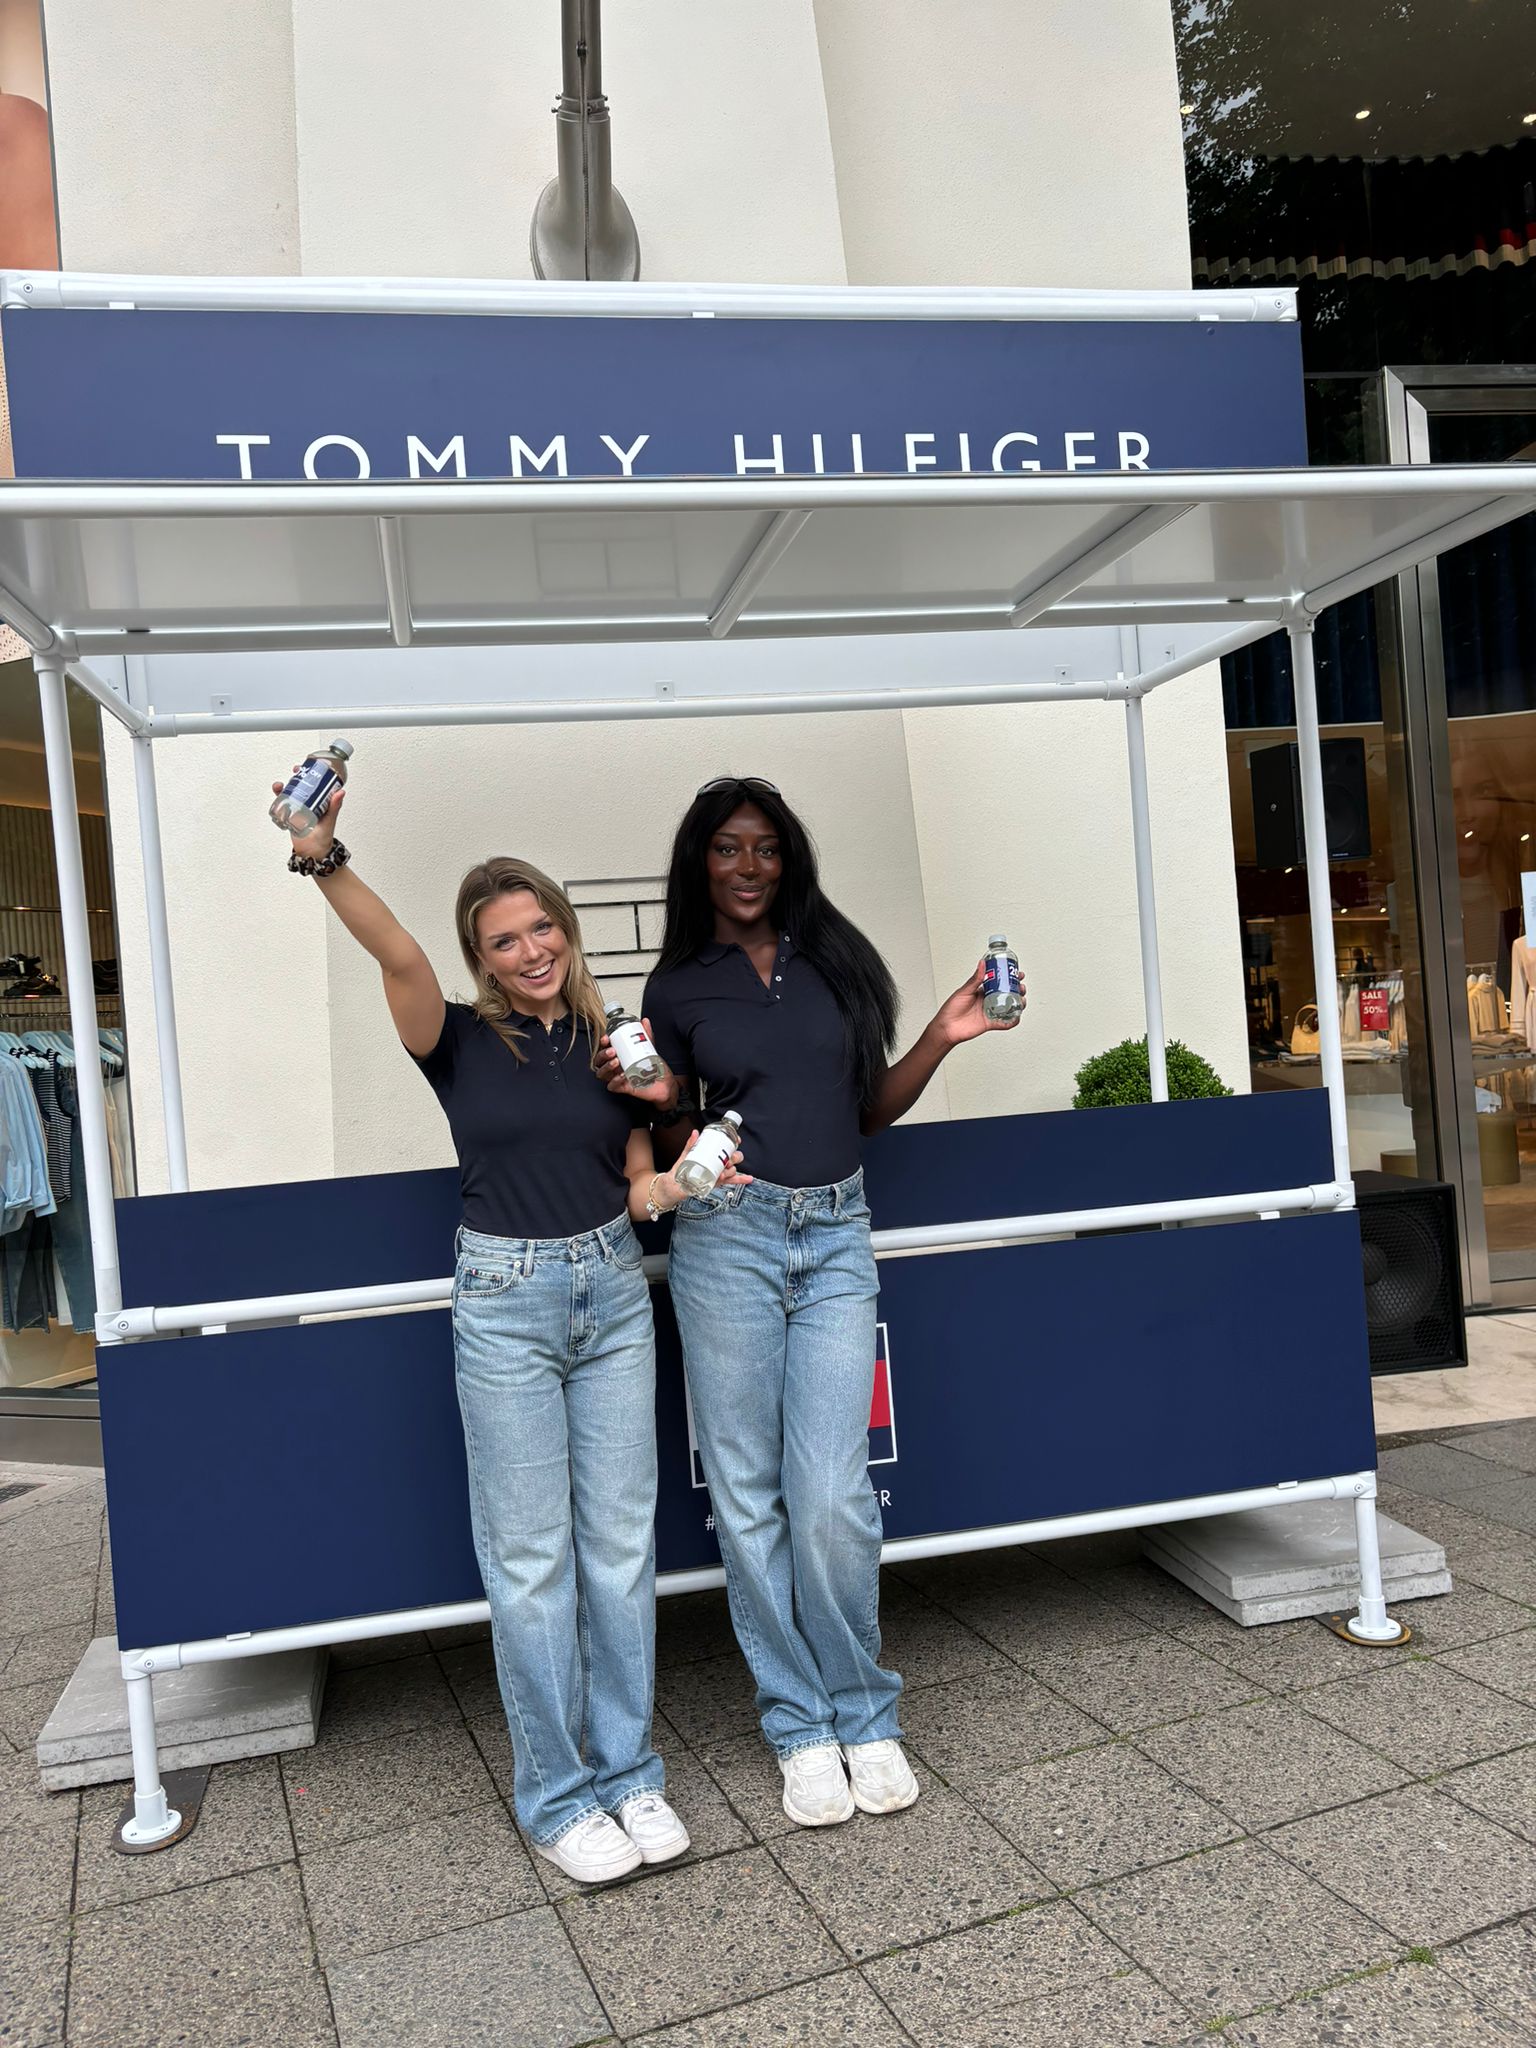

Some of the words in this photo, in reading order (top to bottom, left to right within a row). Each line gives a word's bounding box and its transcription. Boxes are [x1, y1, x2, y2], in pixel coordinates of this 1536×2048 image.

[216, 434, 650, 480] TOMMY
[733, 431, 1151, 474] HILFIGER
[1361, 991, 1382, 1000] SALE
[1363, 1006, 1383, 1014] 50%
